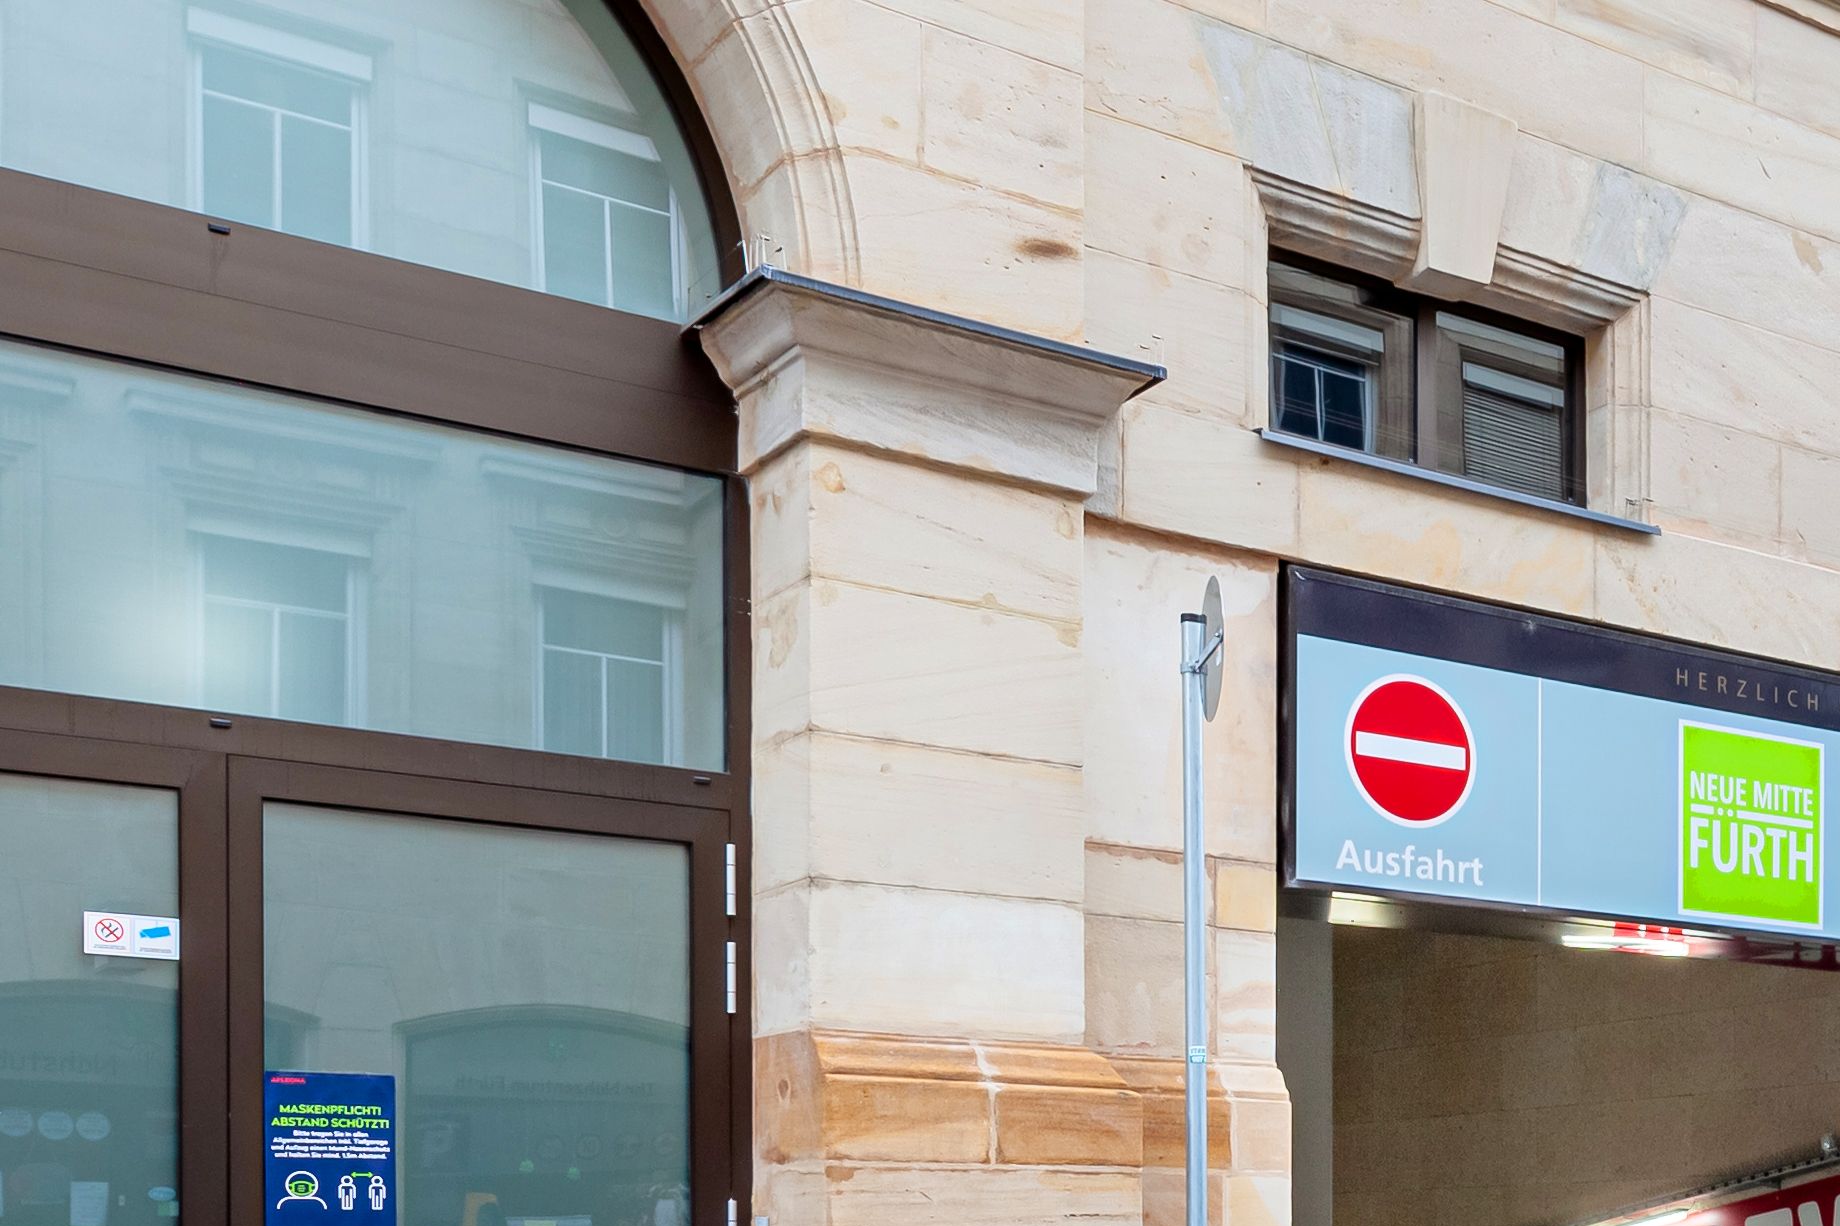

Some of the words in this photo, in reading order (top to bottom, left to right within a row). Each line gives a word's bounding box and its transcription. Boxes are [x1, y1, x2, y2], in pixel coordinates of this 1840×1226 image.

[1676, 667, 1819, 711] HERZLICH
[1689, 770, 1747, 806] NEUE
[1753, 780, 1813, 816] MITTE
[1335, 838, 1484, 886] Ausfahrt
[1689, 808, 1813, 882] FÜRTH
[271, 1116, 329, 1127] ABSTAND
